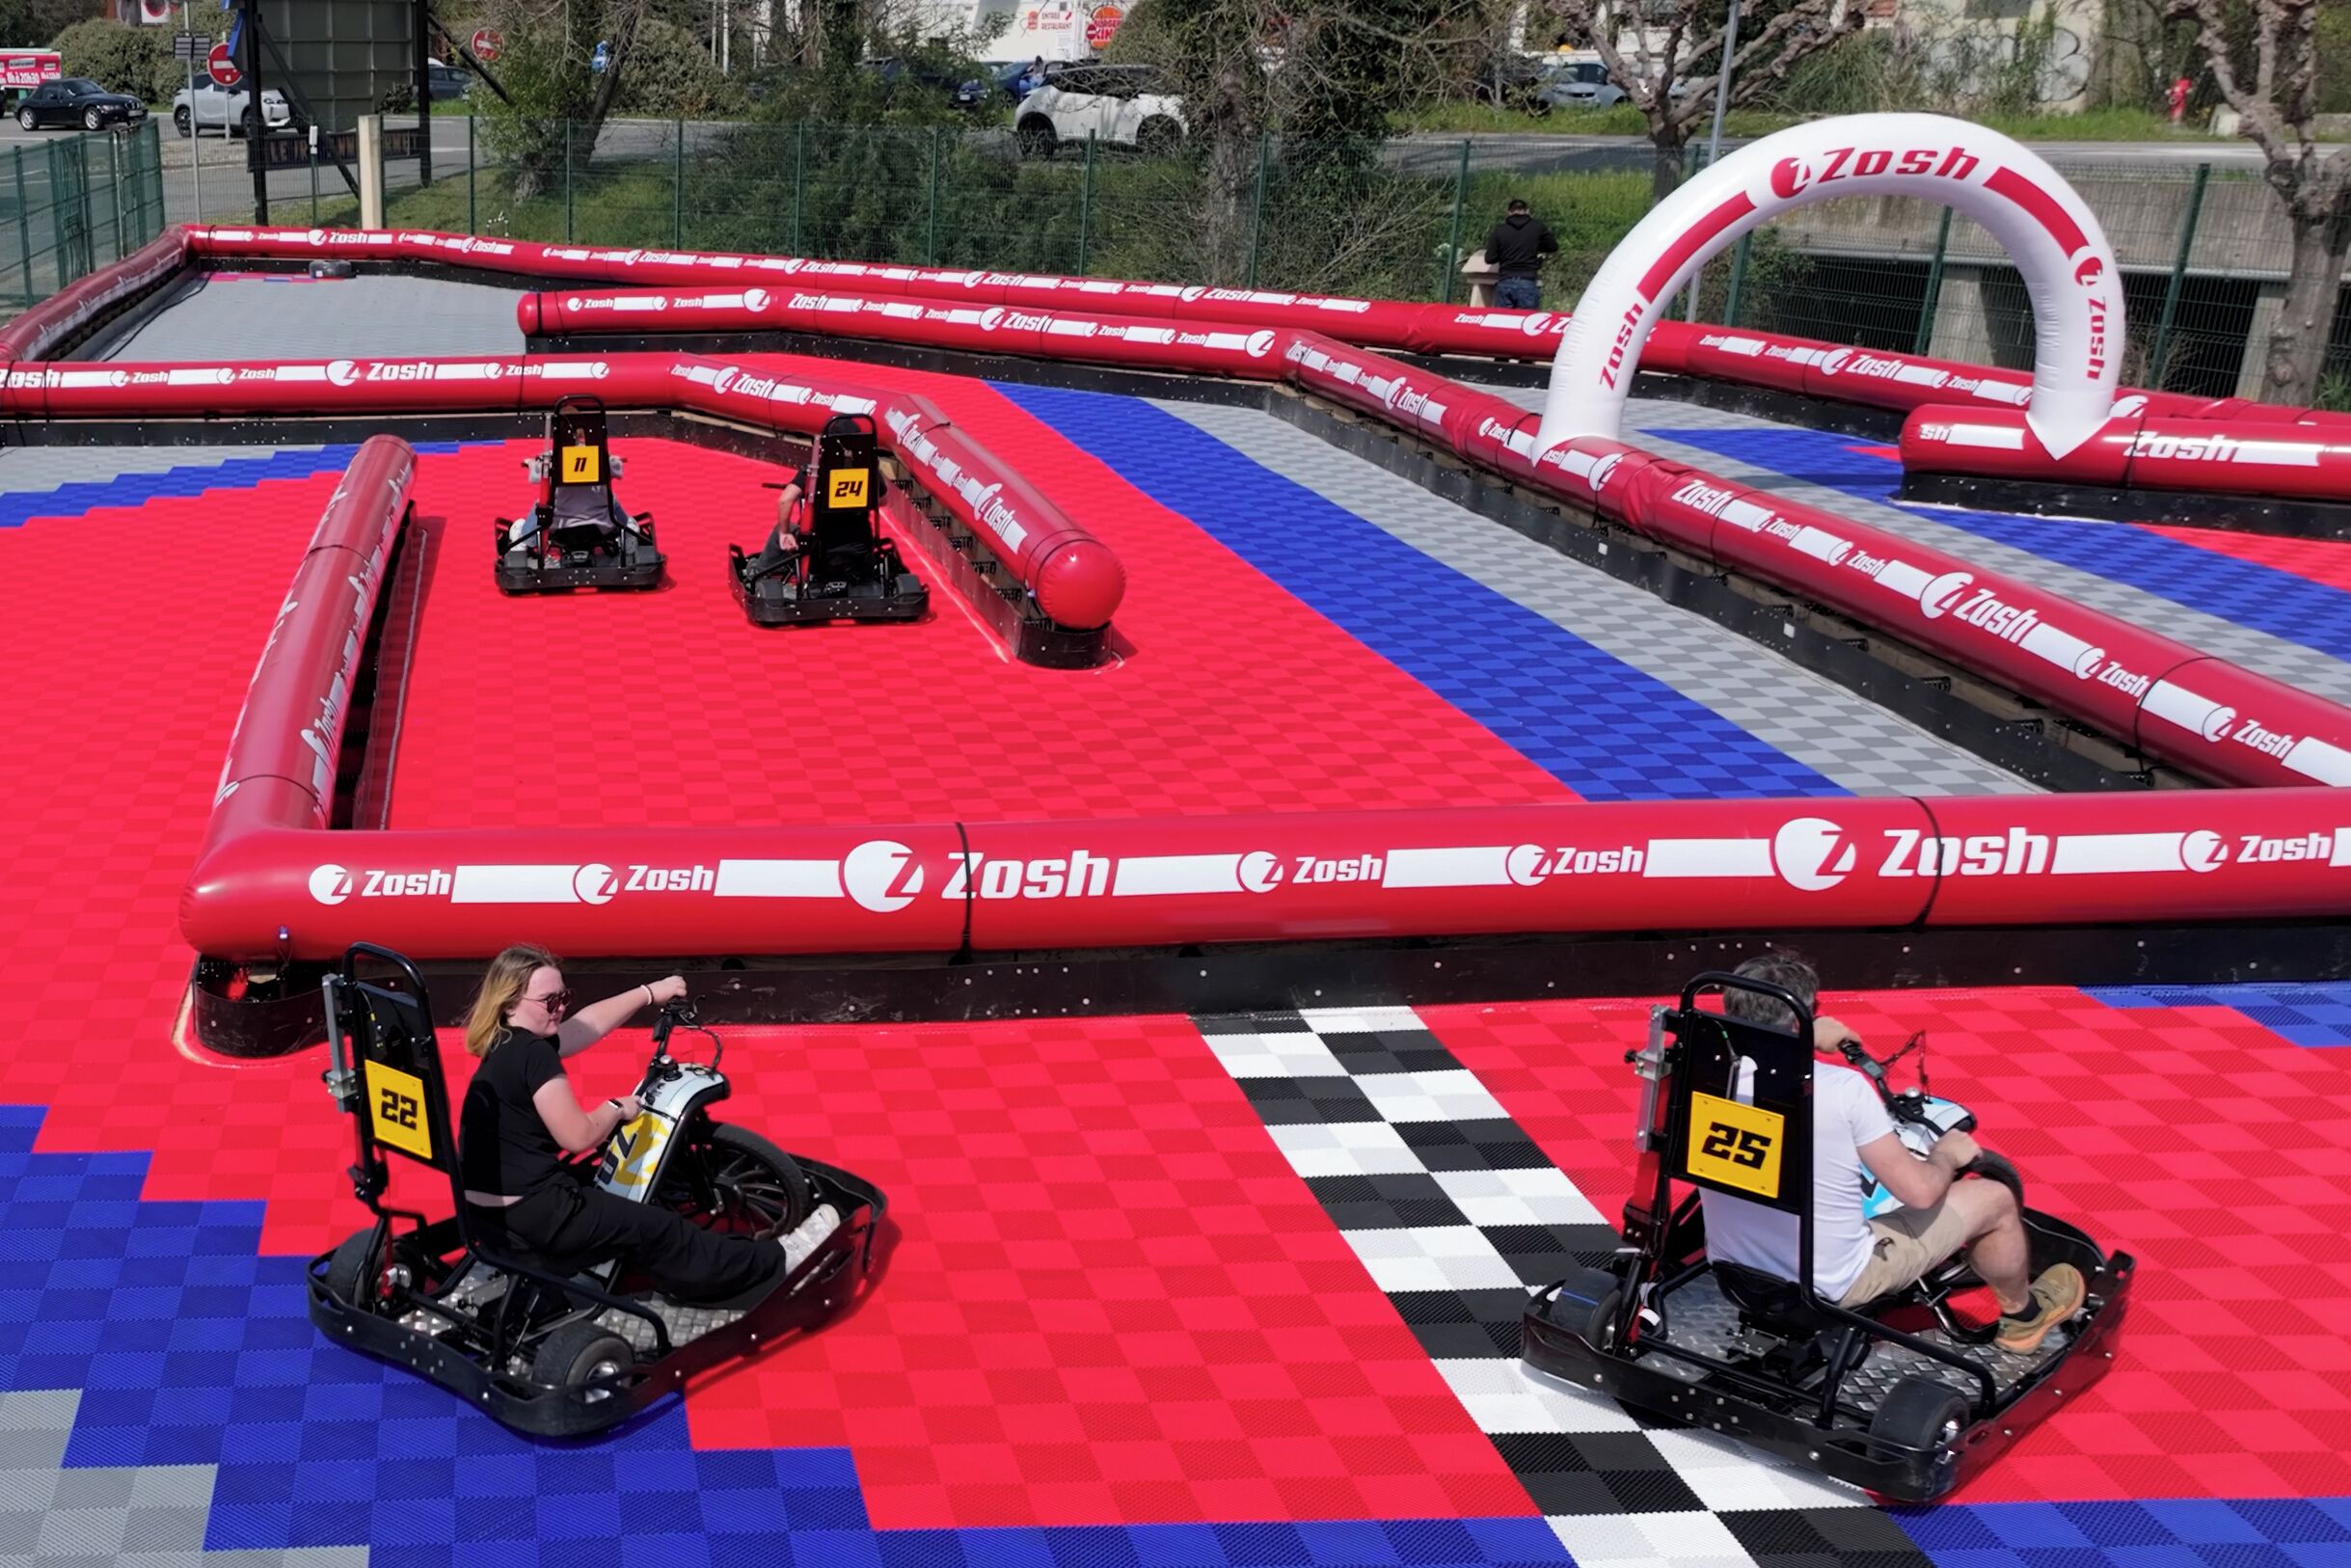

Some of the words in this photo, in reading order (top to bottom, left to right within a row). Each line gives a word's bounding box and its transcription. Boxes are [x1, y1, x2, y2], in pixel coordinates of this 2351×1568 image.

[1818, 147, 1980, 182] Zosh
[329, 231, 368, 244] Zosh
[584, 298, 614, 309] Zosh
[673, 297, 703, 308] Zosh
[788, 292, 826, 310] Zosh
[982, 273, 1023, 286] Zosh
[1203, 288, 1254, 301] Zosh
[1002, 312, 1051, 333] Zosh
[1601, 303, 1643, 390] Zosh
[2087, 296, 2106, 380] Zosh
[0, 368, 61, 389] Zosh
[131, 371, 168, 384] Zosh
[239, 367, 276, 380] Zosh
[366, 362, 435, 381] Zosh
[505, 364, 542, 377] Zosh
[732, 373, 775, 400] Zosh
[1846, 354, 1905, 379] Zosh
[1948, 375, 1981, 392] Zosh
[1543, 448, 1567, 466] osh
[2123, 431, 2238, 462] Zosh
[574, 457, 587, 473] 11
[834, 481, 863, 498] 24
[1671, 479, 1737, 515] Zosh
[1766, 517, 1801, 541] Zosh
[1847, 550, 1886, 578] Zosh
[1953, 587, 2040, 645] Zosh
[2096, 660, 2150, 702] Zosh
[2231, 718, 2294, 760] Zosh
[362, 870, 451, 896] Zosh
[625, 865, 714, 892] Zosh
[941, 850, 1110, 899] Zosh
[1292, 853, 1383, 884] Zosh
[1553, 846, 1644, 876] Zosh
[1878, 827, 2050, 878] Zosh
[2236, 832, 2331, 863] Zosh
[380, 1088, 419, 1131] 22
[1701, 1122, 1772, 1170] 25
